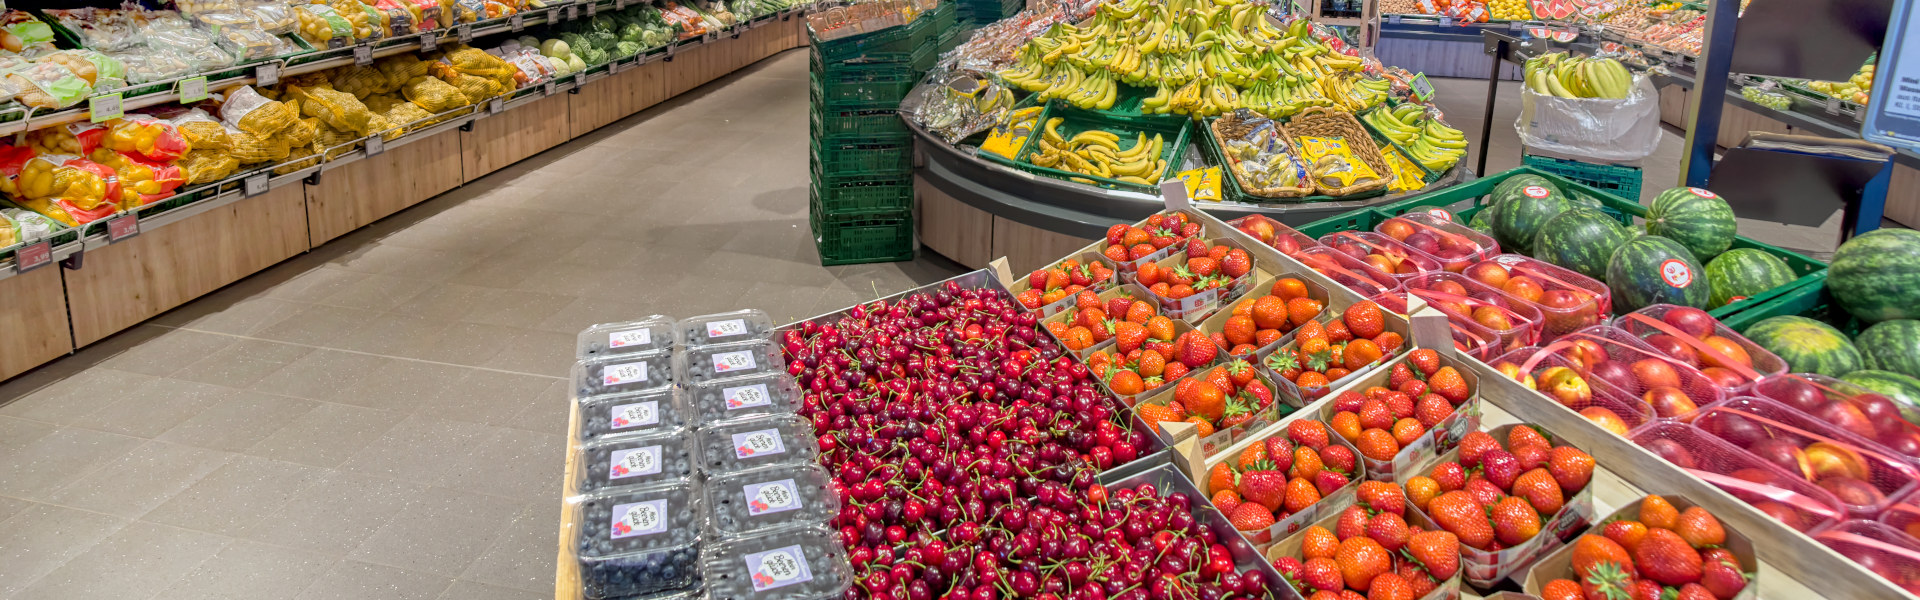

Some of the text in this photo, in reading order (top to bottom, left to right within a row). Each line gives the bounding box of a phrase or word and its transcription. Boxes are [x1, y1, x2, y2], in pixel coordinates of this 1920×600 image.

[34, 253, 49, 262] 3,99
[756, 434, 768, 449] Beeren
[636, 452, 645, 468] Beeren
[763, 490, 776, 504] glück
[770, 486, 784, 504] Beeren
[629, 511, 639, 526] glück
[639, 506, 649, 527] Beeren
[765, 559, 780, 576] glück
[773, 554, 791, 576] Beeren
[788, 559, 796, 570] Mein
